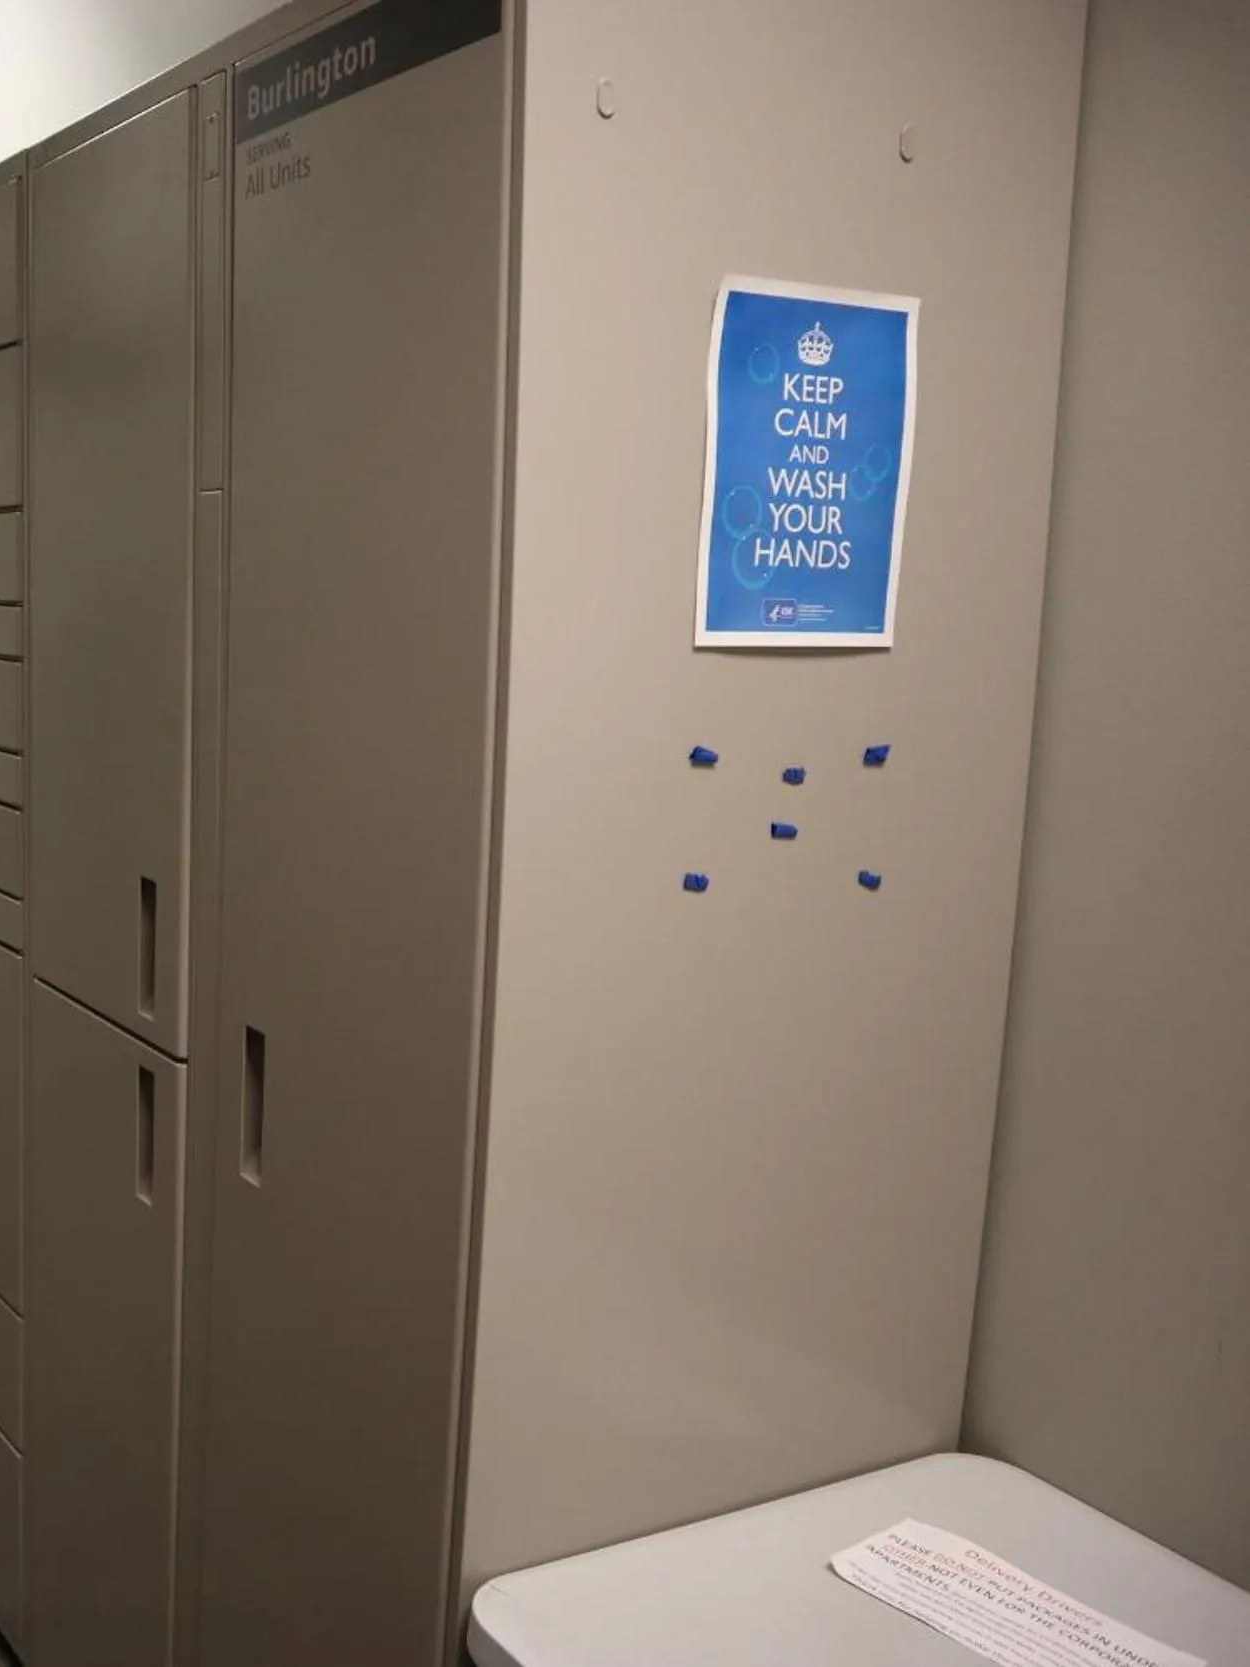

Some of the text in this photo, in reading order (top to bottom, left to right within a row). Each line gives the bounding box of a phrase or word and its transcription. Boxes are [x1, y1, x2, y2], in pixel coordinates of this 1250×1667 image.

[246, 36, 377, 121] Burlington
[245, 154, 312, 200] All Units
[782, 373, 844, 405] KEEP
[774, 408, 848, 440] CALM
[789, 445, 830, 465] AND
[768, 467, 847, 500] WASH
[769, 503, 843, 535] YOUR
[753, 539, 852, 570] HANDS
[964, 1549, 1034, 1593] Delivery
[888, 1534, 931, 1556] PLEASE
[988, 1579, 1015, 1597] PUT
[1016, 1596, 1090, 1636] PACKAGES
[1093, 1632, 1111, 1647] IN
[959, 1577, 995, 1601] EVEN
[1029, 1612, 1054, 1629] THE
